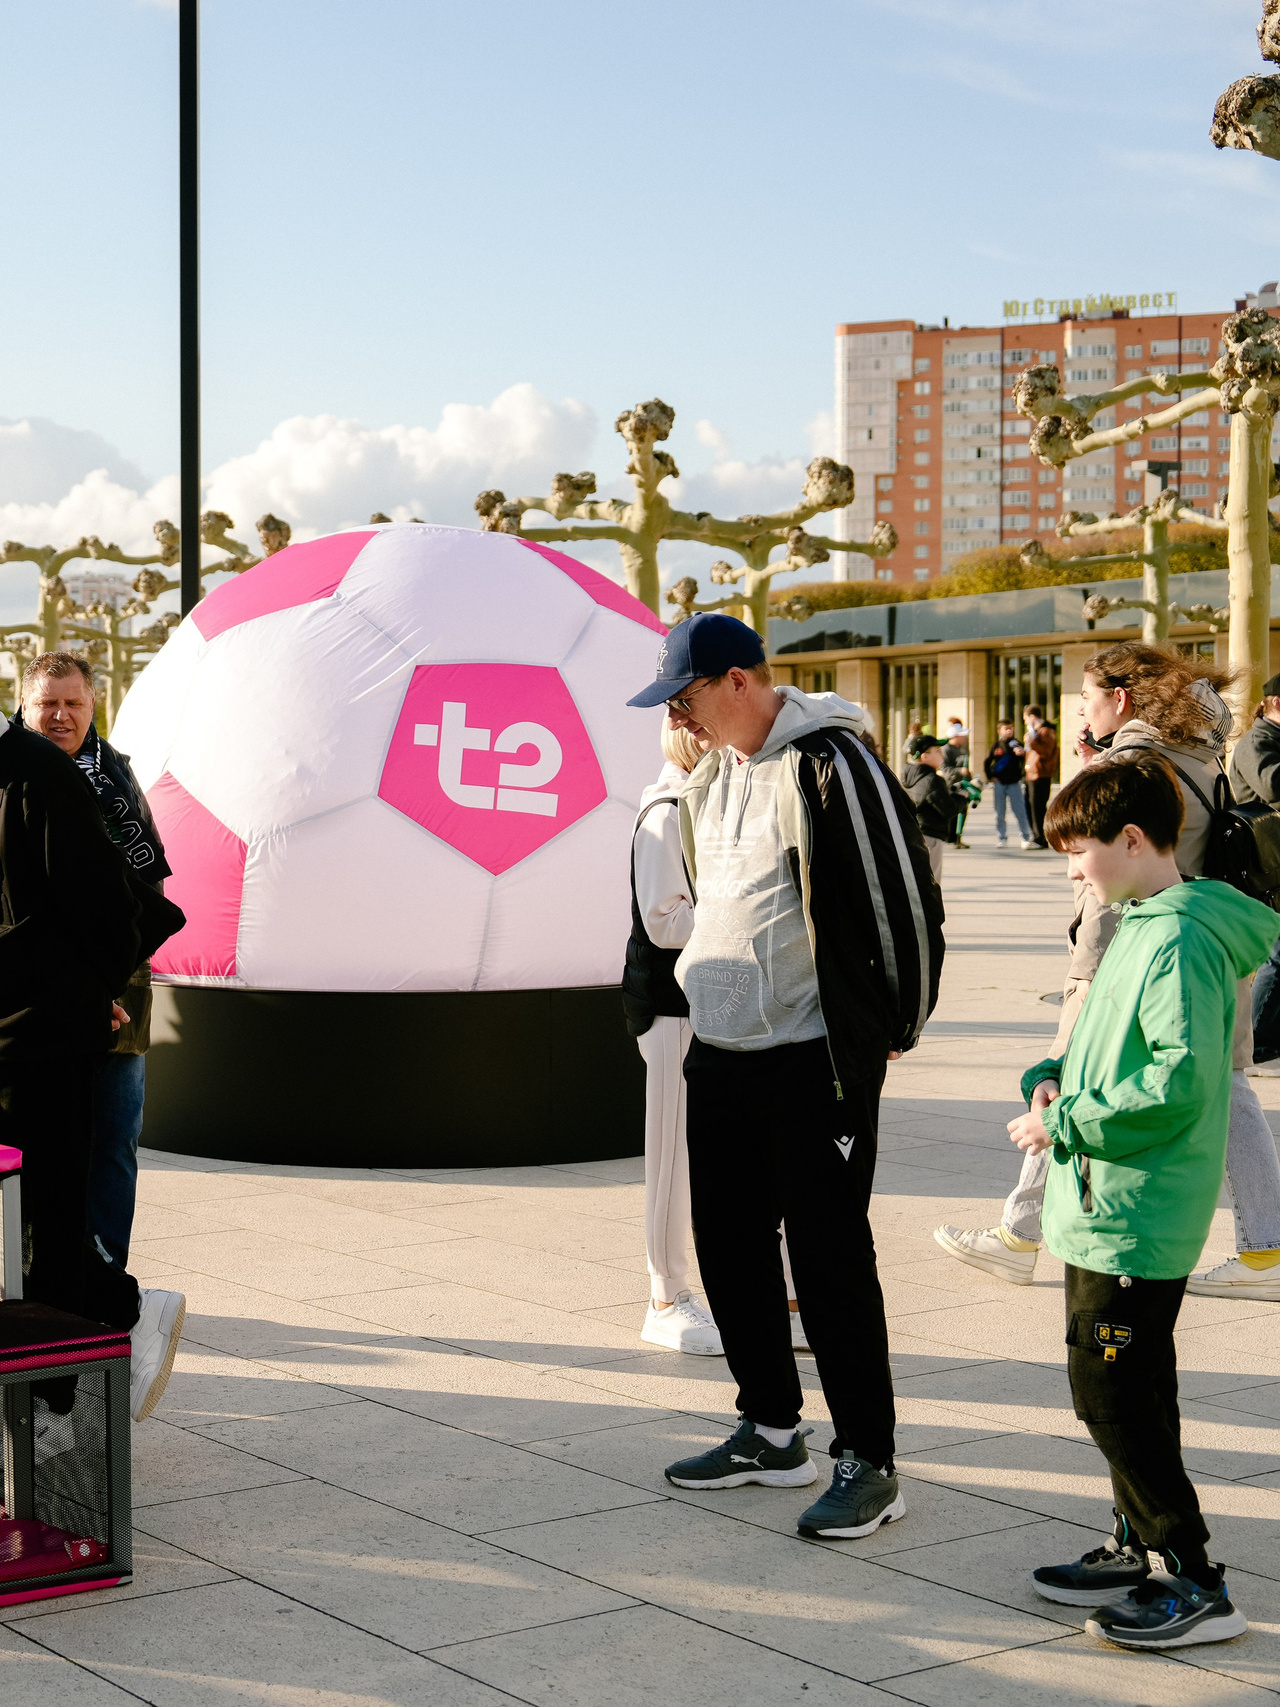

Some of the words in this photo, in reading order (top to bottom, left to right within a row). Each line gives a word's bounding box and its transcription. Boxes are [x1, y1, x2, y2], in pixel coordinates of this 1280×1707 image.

[414, 701, 563, 817] t2
[699, 968, 732, 983] BRAND
[714, 973, 750, 1025] STRIPES
